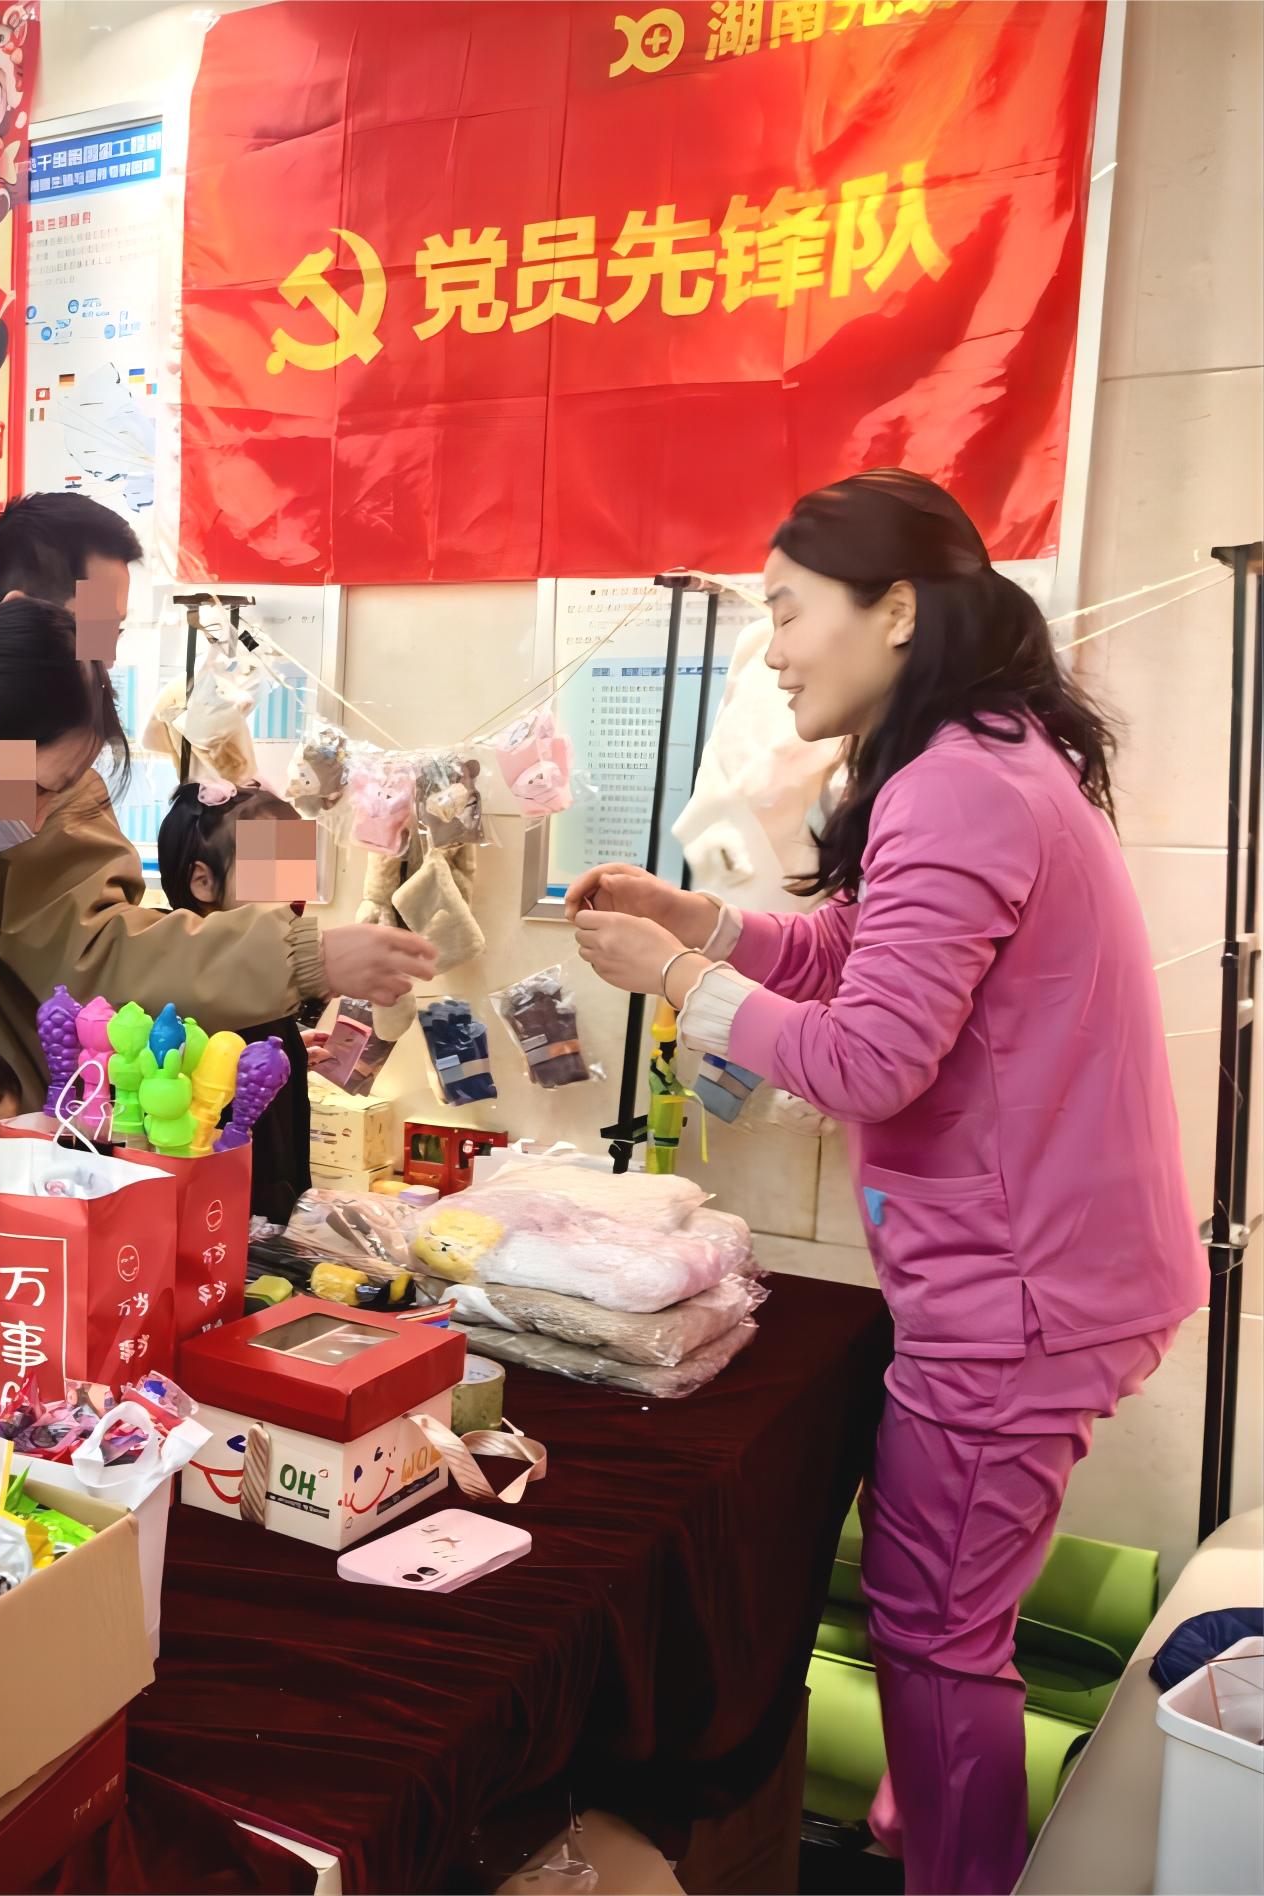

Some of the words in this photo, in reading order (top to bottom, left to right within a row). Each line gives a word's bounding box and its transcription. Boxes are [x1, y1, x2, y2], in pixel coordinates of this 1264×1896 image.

[413, 160, 952, 341] 党员先锋队
[279, 1463, 317, 1500] OH
